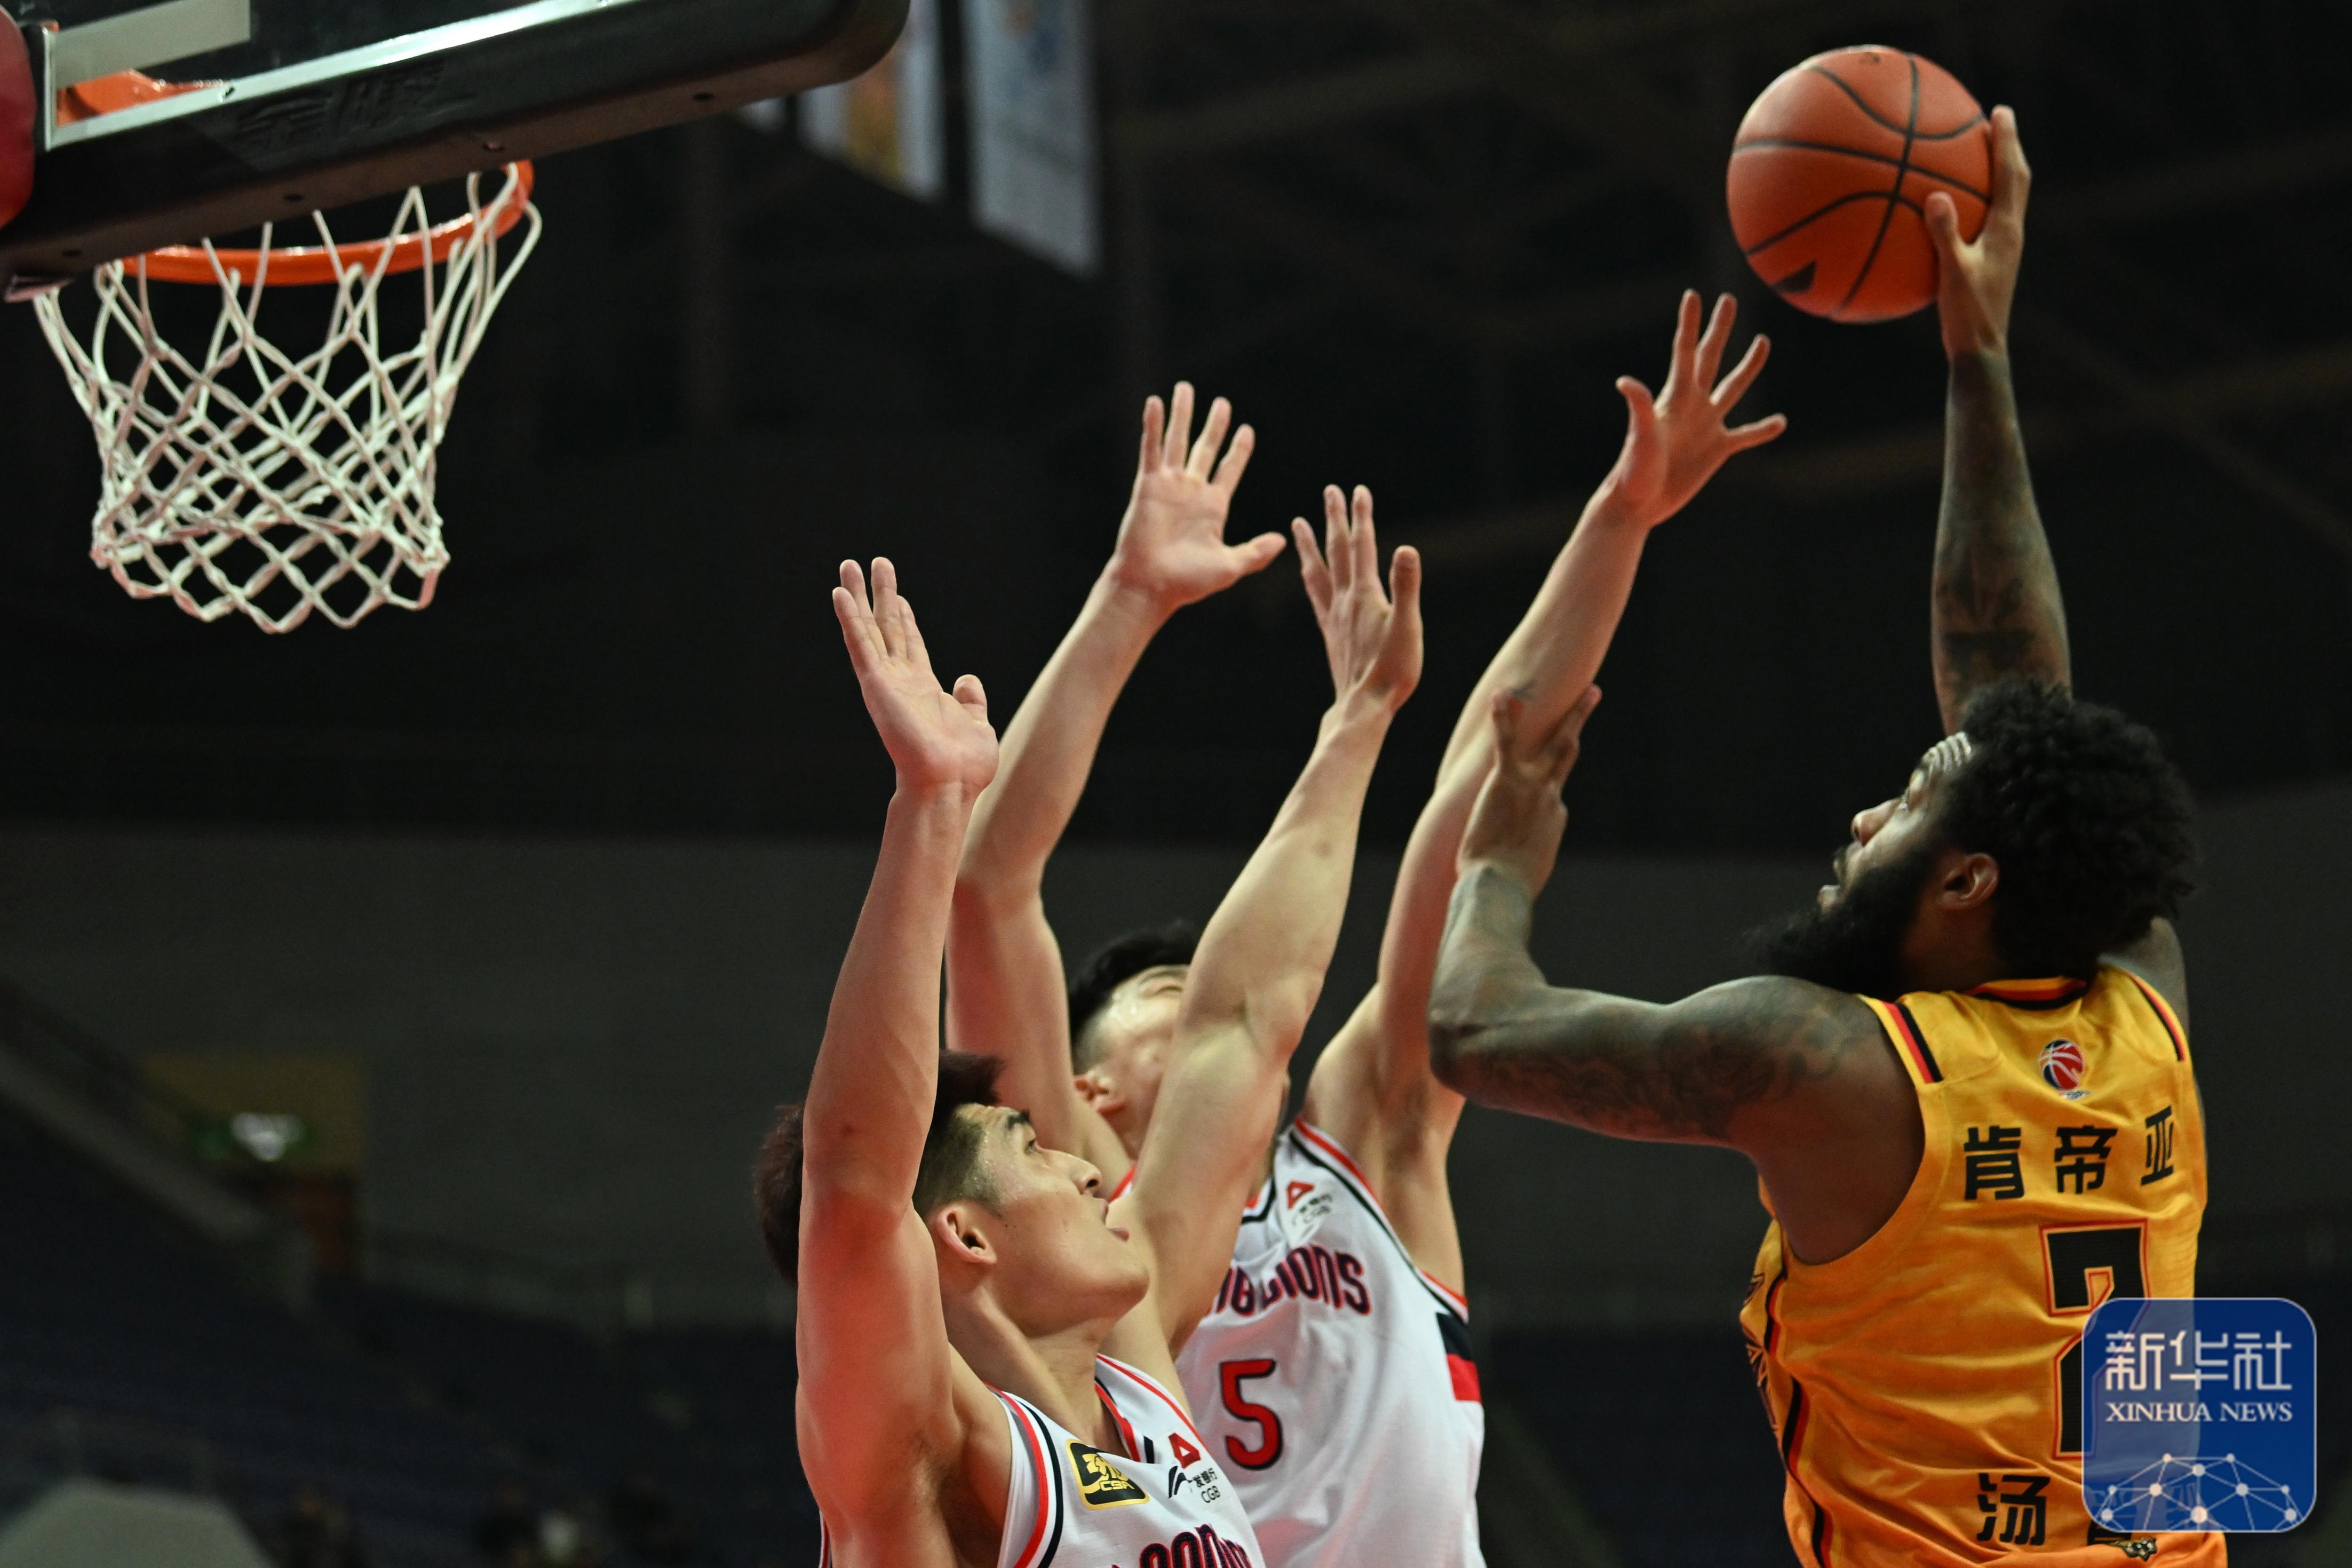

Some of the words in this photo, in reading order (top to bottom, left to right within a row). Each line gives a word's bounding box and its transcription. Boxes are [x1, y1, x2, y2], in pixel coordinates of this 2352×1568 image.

[1963, 1105, 2174, 1200] 肯帝亚
[1219, 1359, 1283, 1471] 5
[1201, 1485, 1221, 1503] CGB
